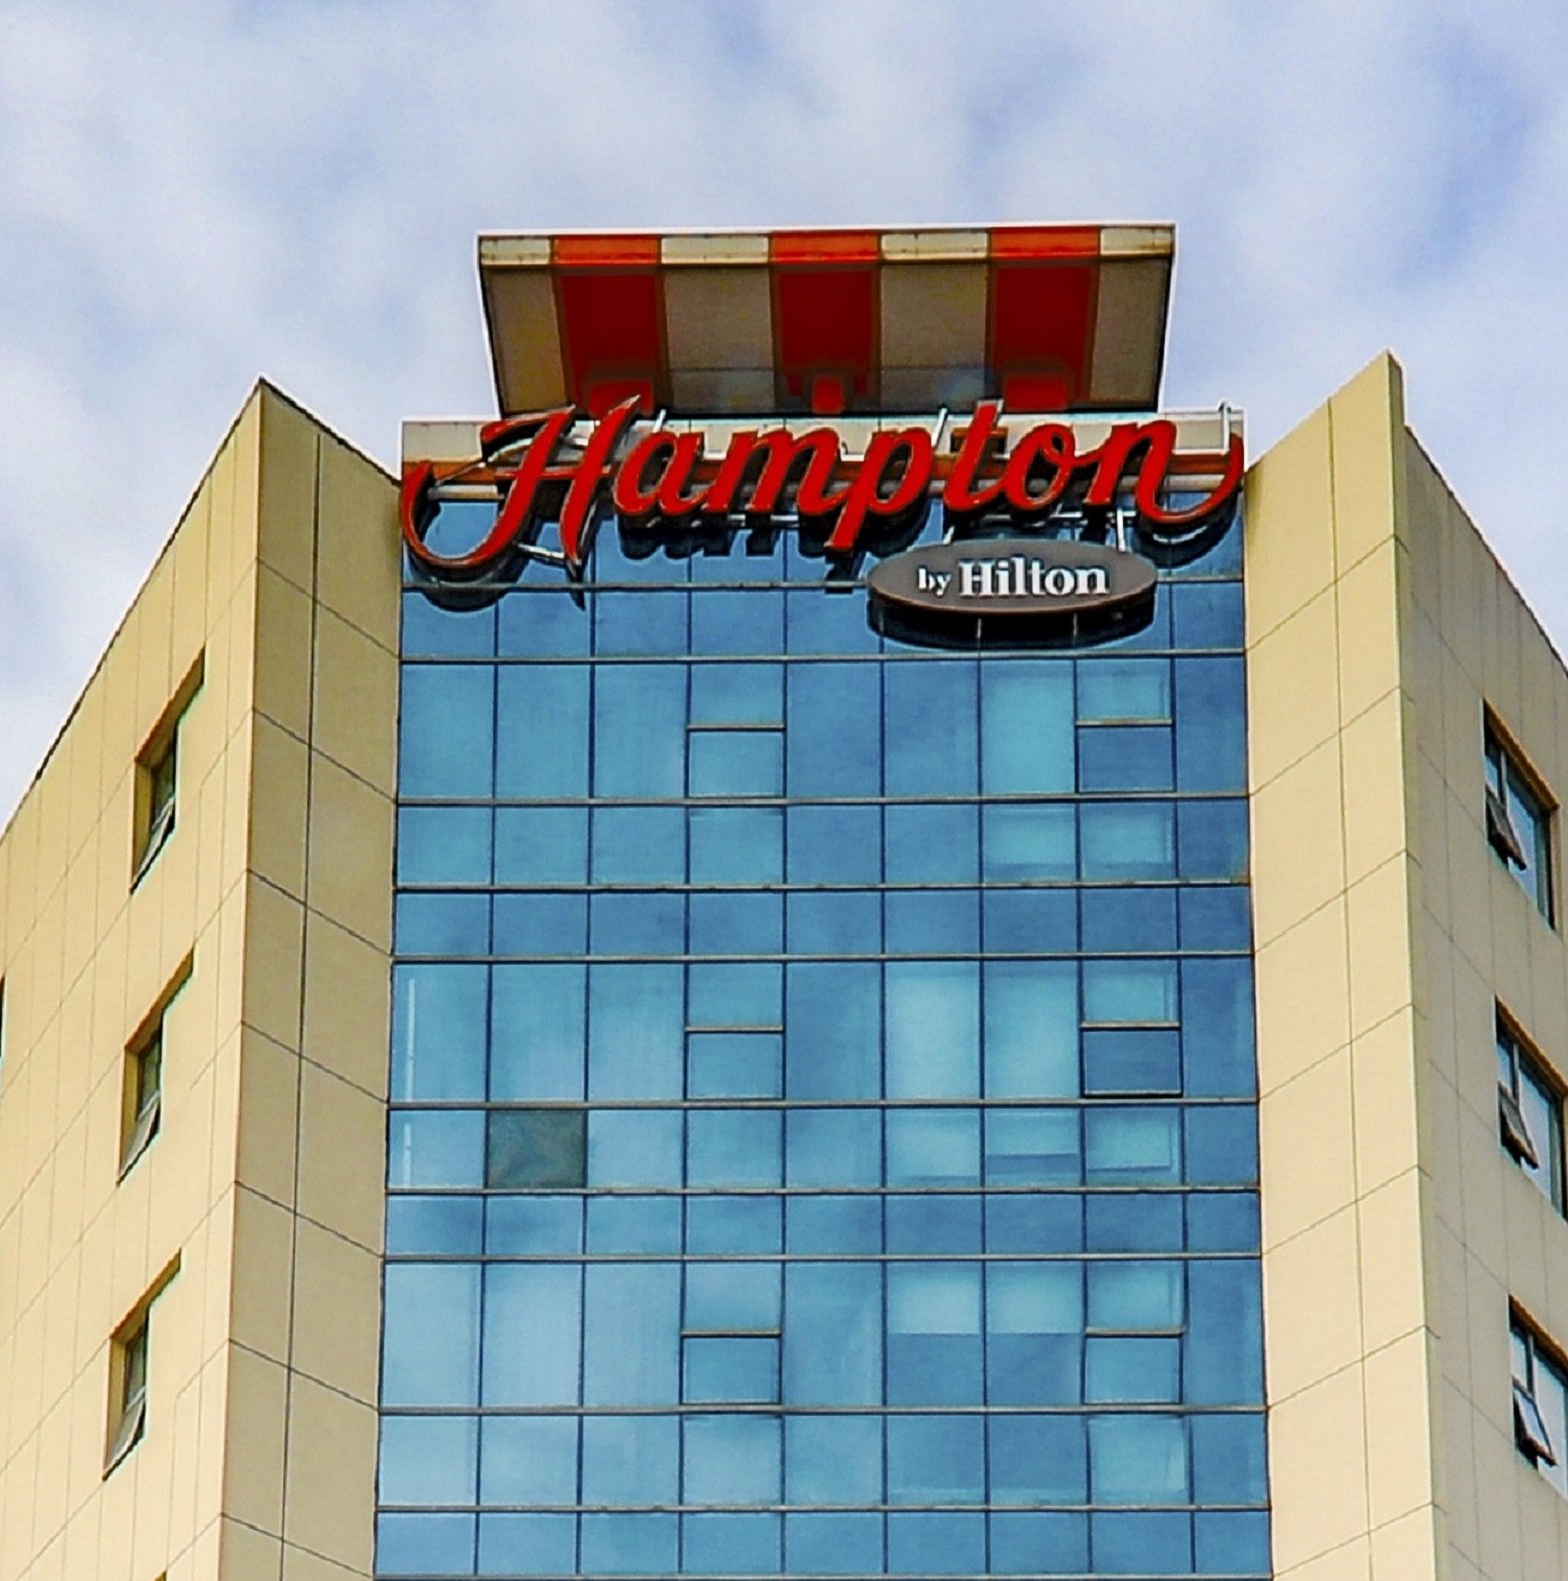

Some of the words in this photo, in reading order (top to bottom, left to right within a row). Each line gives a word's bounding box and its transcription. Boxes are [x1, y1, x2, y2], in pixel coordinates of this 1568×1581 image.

[401, 395, 1246, 572] Hampton
[917, 567, 952, 597] by
[958, 556, 1111, 598] Hilton
